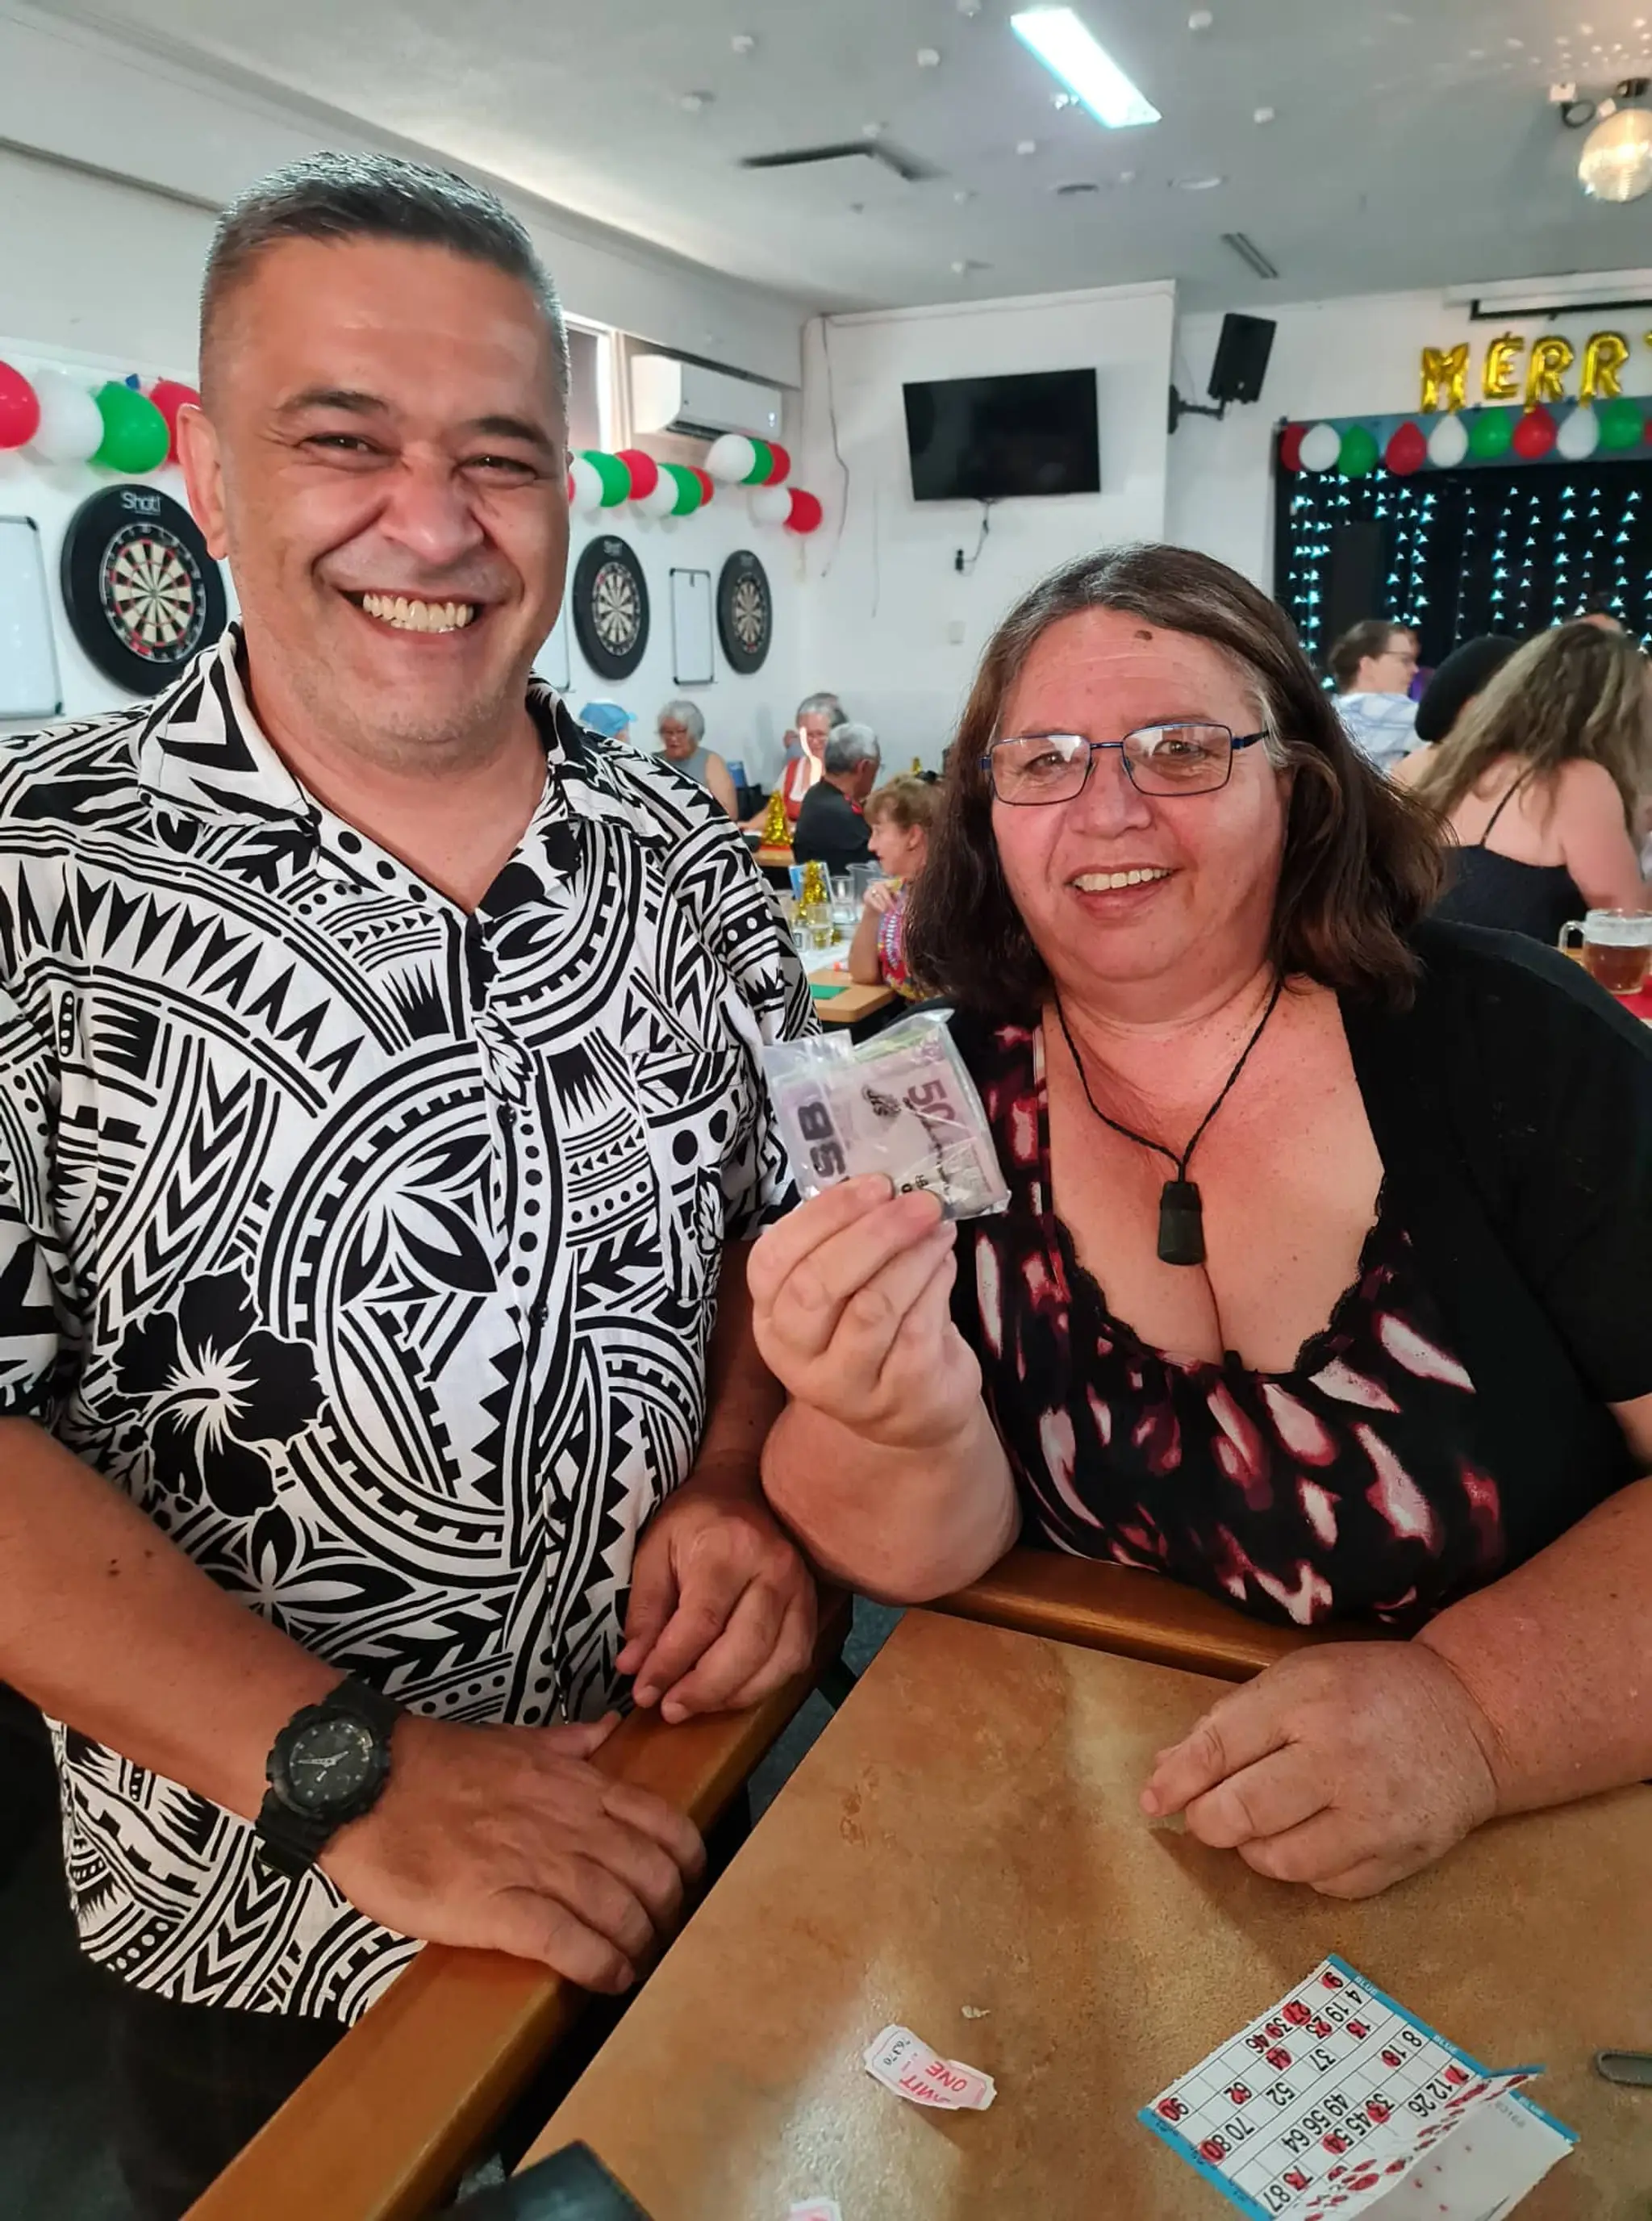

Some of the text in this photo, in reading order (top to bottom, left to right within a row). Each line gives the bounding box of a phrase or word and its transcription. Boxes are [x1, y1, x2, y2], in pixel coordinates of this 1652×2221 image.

[1420, 330, 1652, 414] MERR
[907, 1079, 956, 1121] 50
[1344, 1989, 1362, 2004] 4
[1325, 2002, 1349, 2022] 19
[1305, 2014, 1332, 2039] 23
[1345, 2018, 1370, 2039] 13
[1401, 2031, 1421, 2047] 8
[1161, 1971, 1343, 2121] 9 27 39 46 90
[1308, 2048, 1336, 2071] 37
[899, 2075, 950, 2102] MIT
[925, 2060, 967, 2092] ONE
[1223, 2081, 1252, 2104] 62
[1265, 2081, 1295, 2106] 52
[1408, 2064, 1469, 2117] 7 12 26
[1323, 2094, 1349, 2116] 49
[1224, 2117, 1254, 2140] 70
[1302, 2110, 1331, 2135] 56
[1345, 2112, 1371, 2135] 45
[1202, 2134, 1232, 2160] 80
[1280, 2128, 1309, 2153] 64
[1324, 2127, 1354, 2152] 54
[1283, 2165, 1313, 2191] 73
[1262, 2184, 1291, 2212] 87
